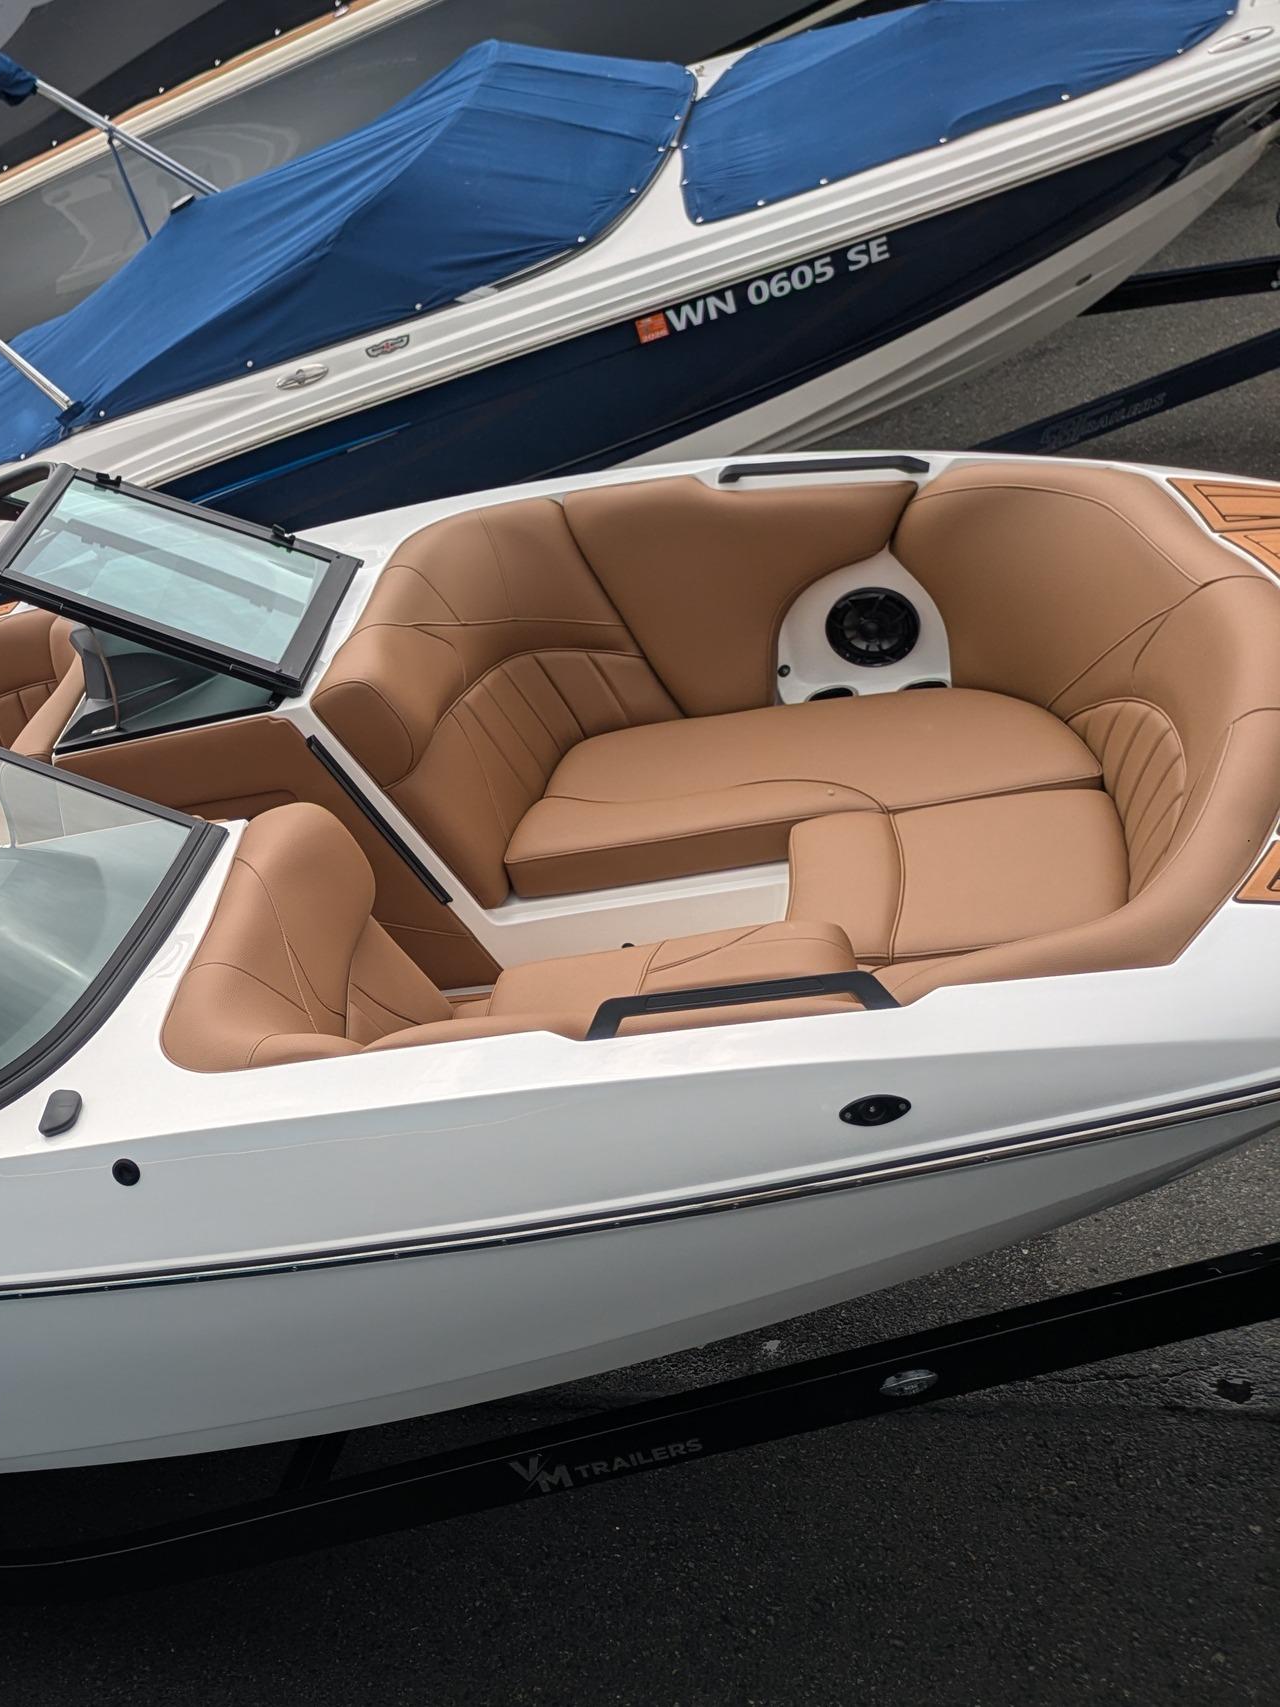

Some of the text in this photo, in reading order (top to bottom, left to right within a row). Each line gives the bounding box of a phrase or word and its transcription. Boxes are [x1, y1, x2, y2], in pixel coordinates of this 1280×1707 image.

[665, 236, 891, 332] WN 0605 SE
[574, 1438, 704, 1479] TRAILERS
